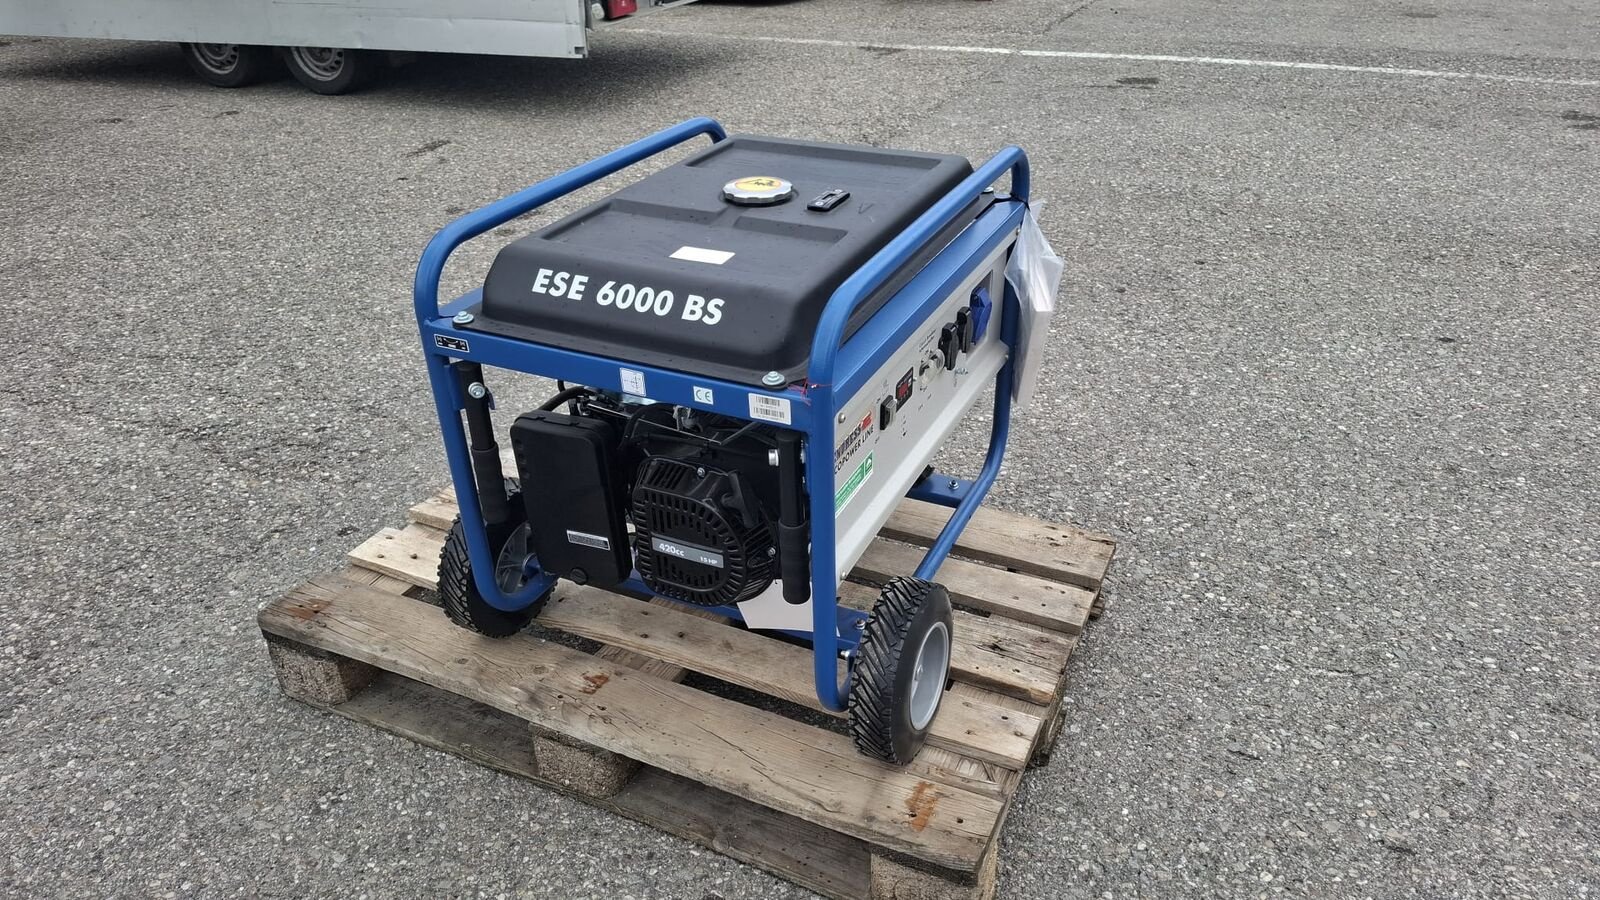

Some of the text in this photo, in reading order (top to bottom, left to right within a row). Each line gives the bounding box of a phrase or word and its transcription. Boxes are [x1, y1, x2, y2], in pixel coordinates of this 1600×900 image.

[532, 268, 725, 325] ESE 6000 BS
[862, 424, 874, 443] LINE
[659, 544, 684, 556] 420cc
